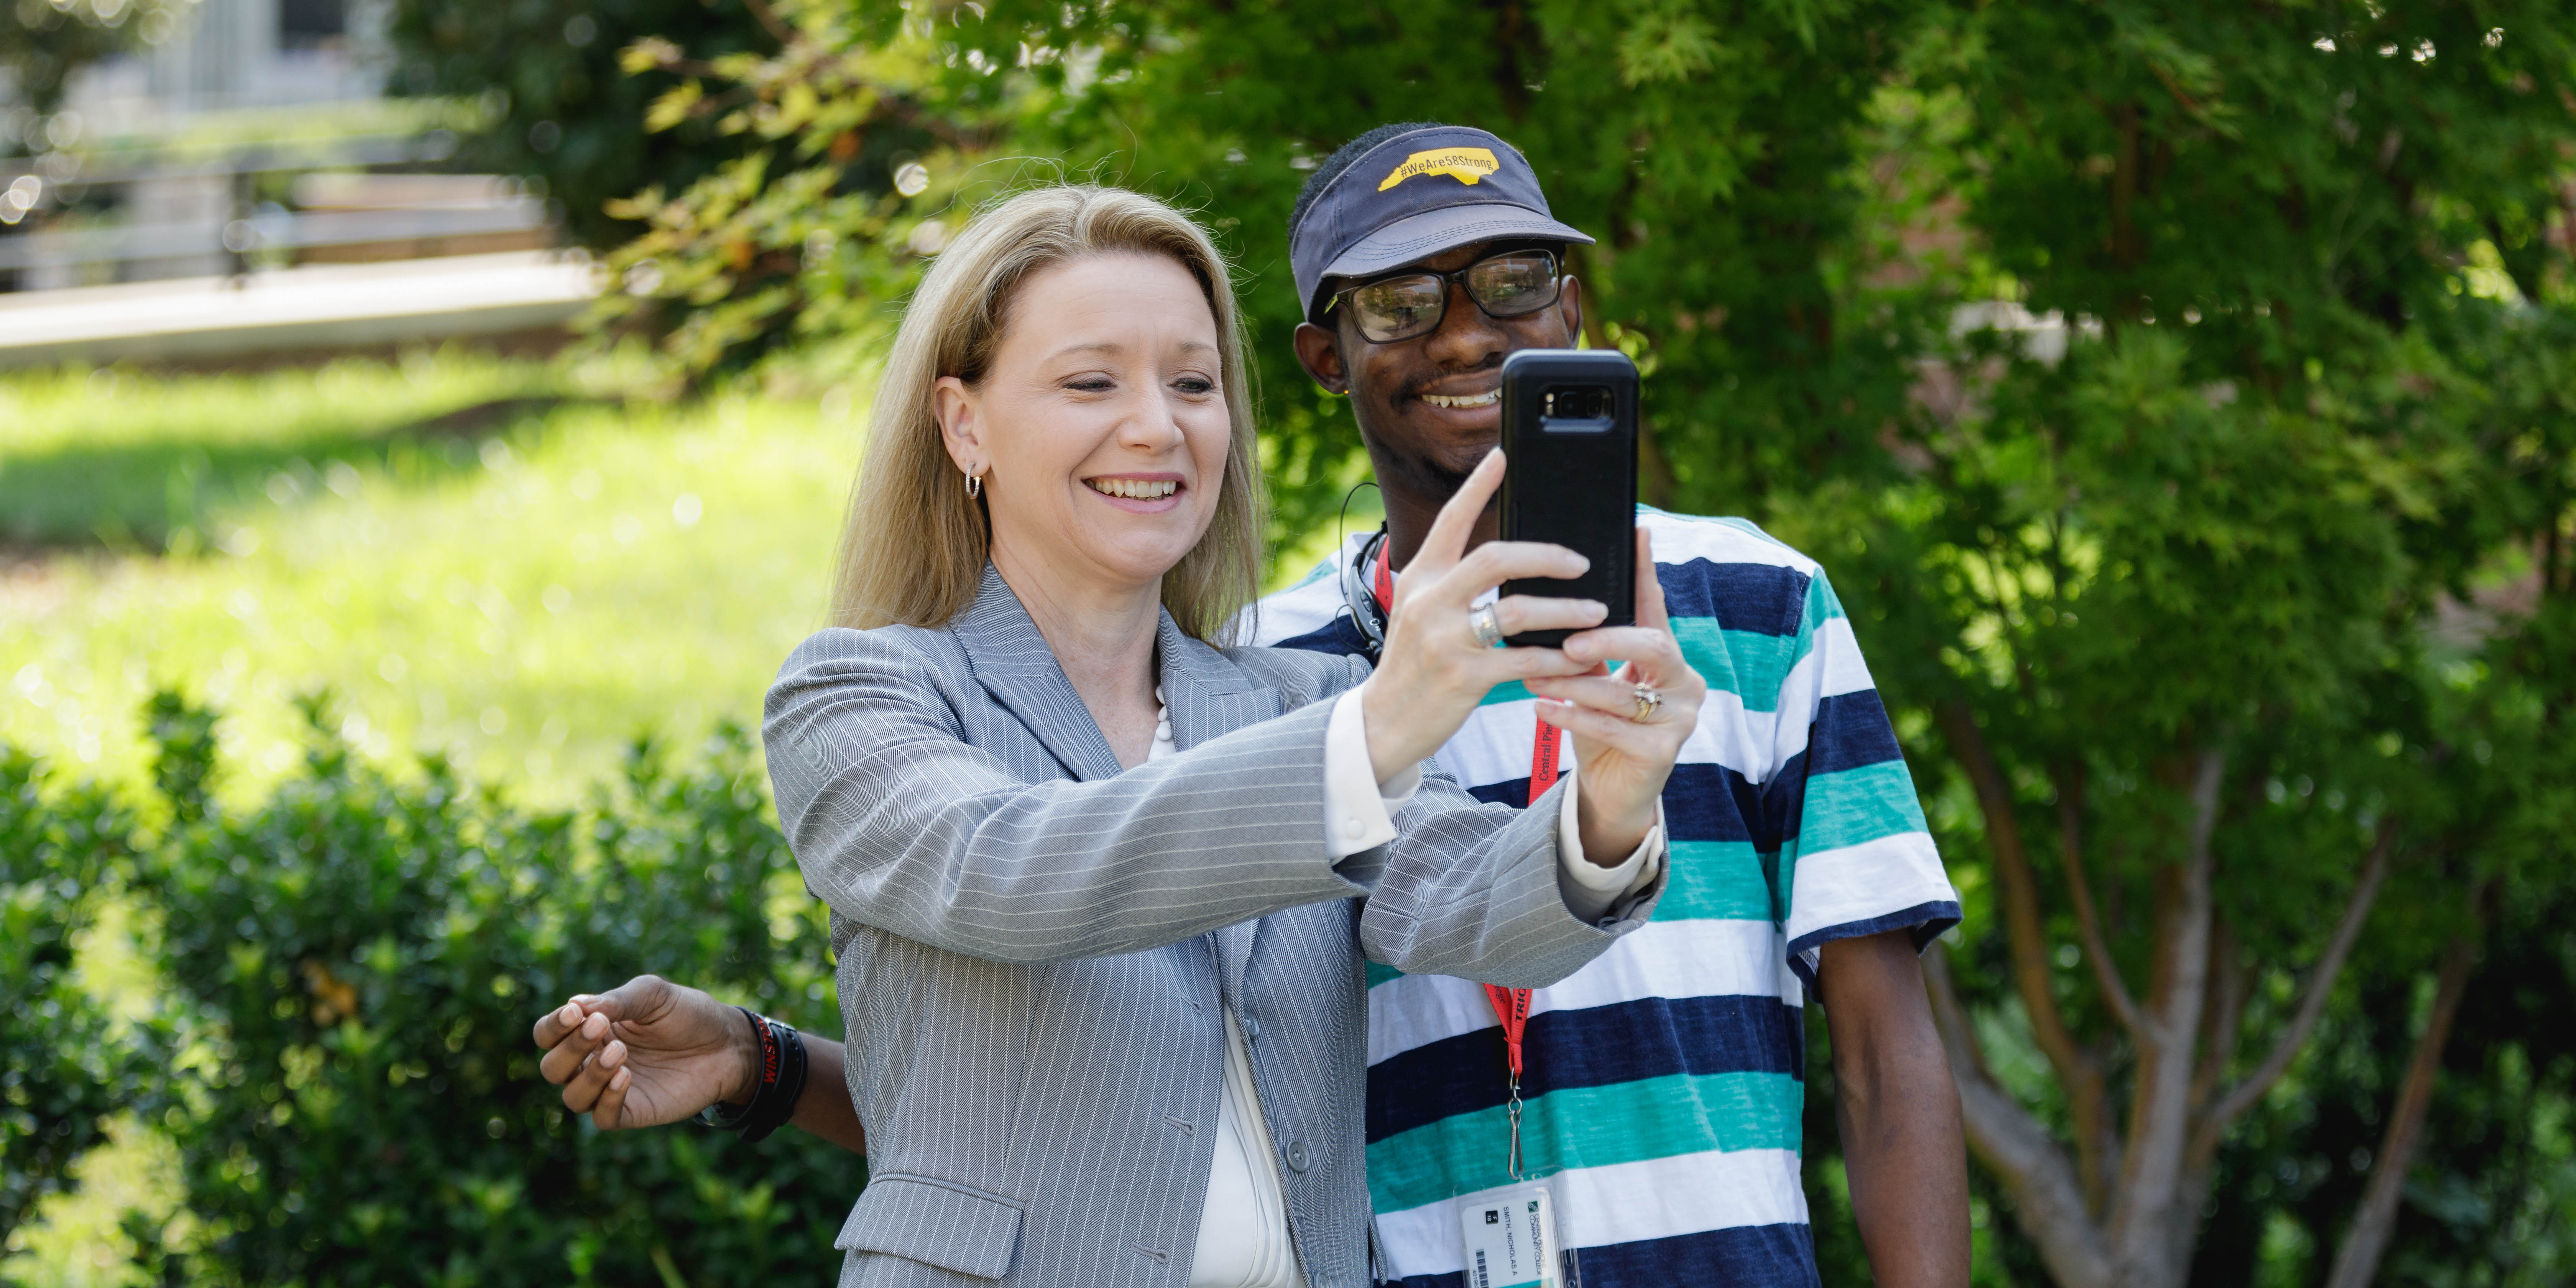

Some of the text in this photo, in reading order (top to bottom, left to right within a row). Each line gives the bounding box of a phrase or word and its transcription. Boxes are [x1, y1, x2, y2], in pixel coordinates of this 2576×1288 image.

[1401, 156, 1493, 177] #WeAre58Strong
[1539, 744, 1551, 781] Central
[1515, 987, 1526, 1022] TRIO
[1530, 1215, 1539, 1250] COMMUNITY
[1507, 1233, 1517, 1269] NICHOLAS
